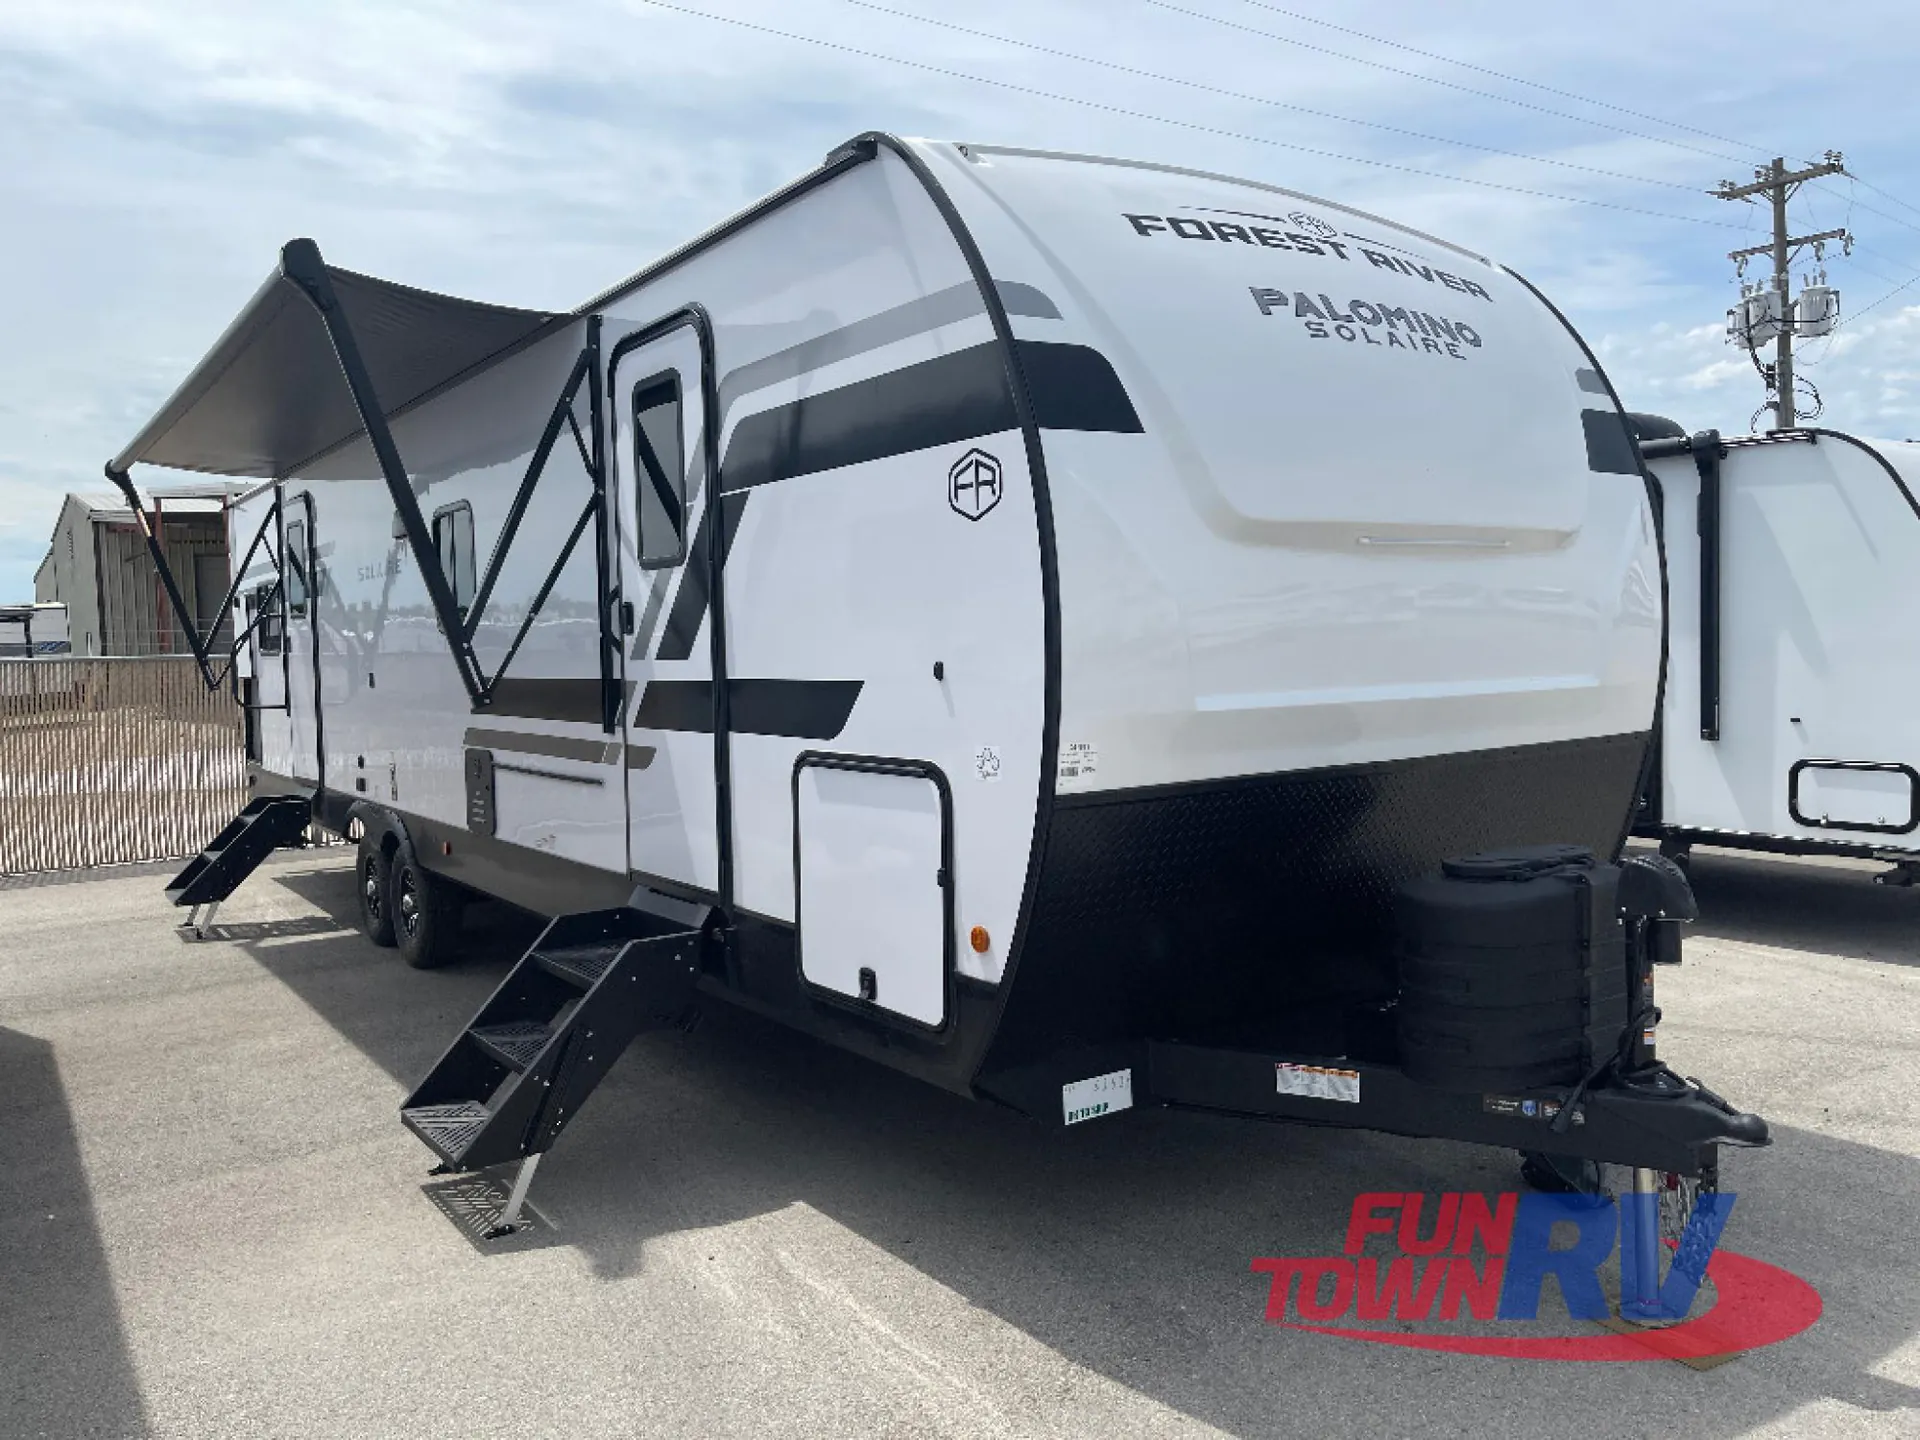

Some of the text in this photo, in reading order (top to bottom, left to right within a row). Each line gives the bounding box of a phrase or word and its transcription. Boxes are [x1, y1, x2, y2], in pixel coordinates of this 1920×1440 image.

[1121, 213, 1494, 303] FOREST RIVER
[1248, 286, 1483, 348] PALOMINO
[1304, 320, 1467, 361] SOLAIRE
